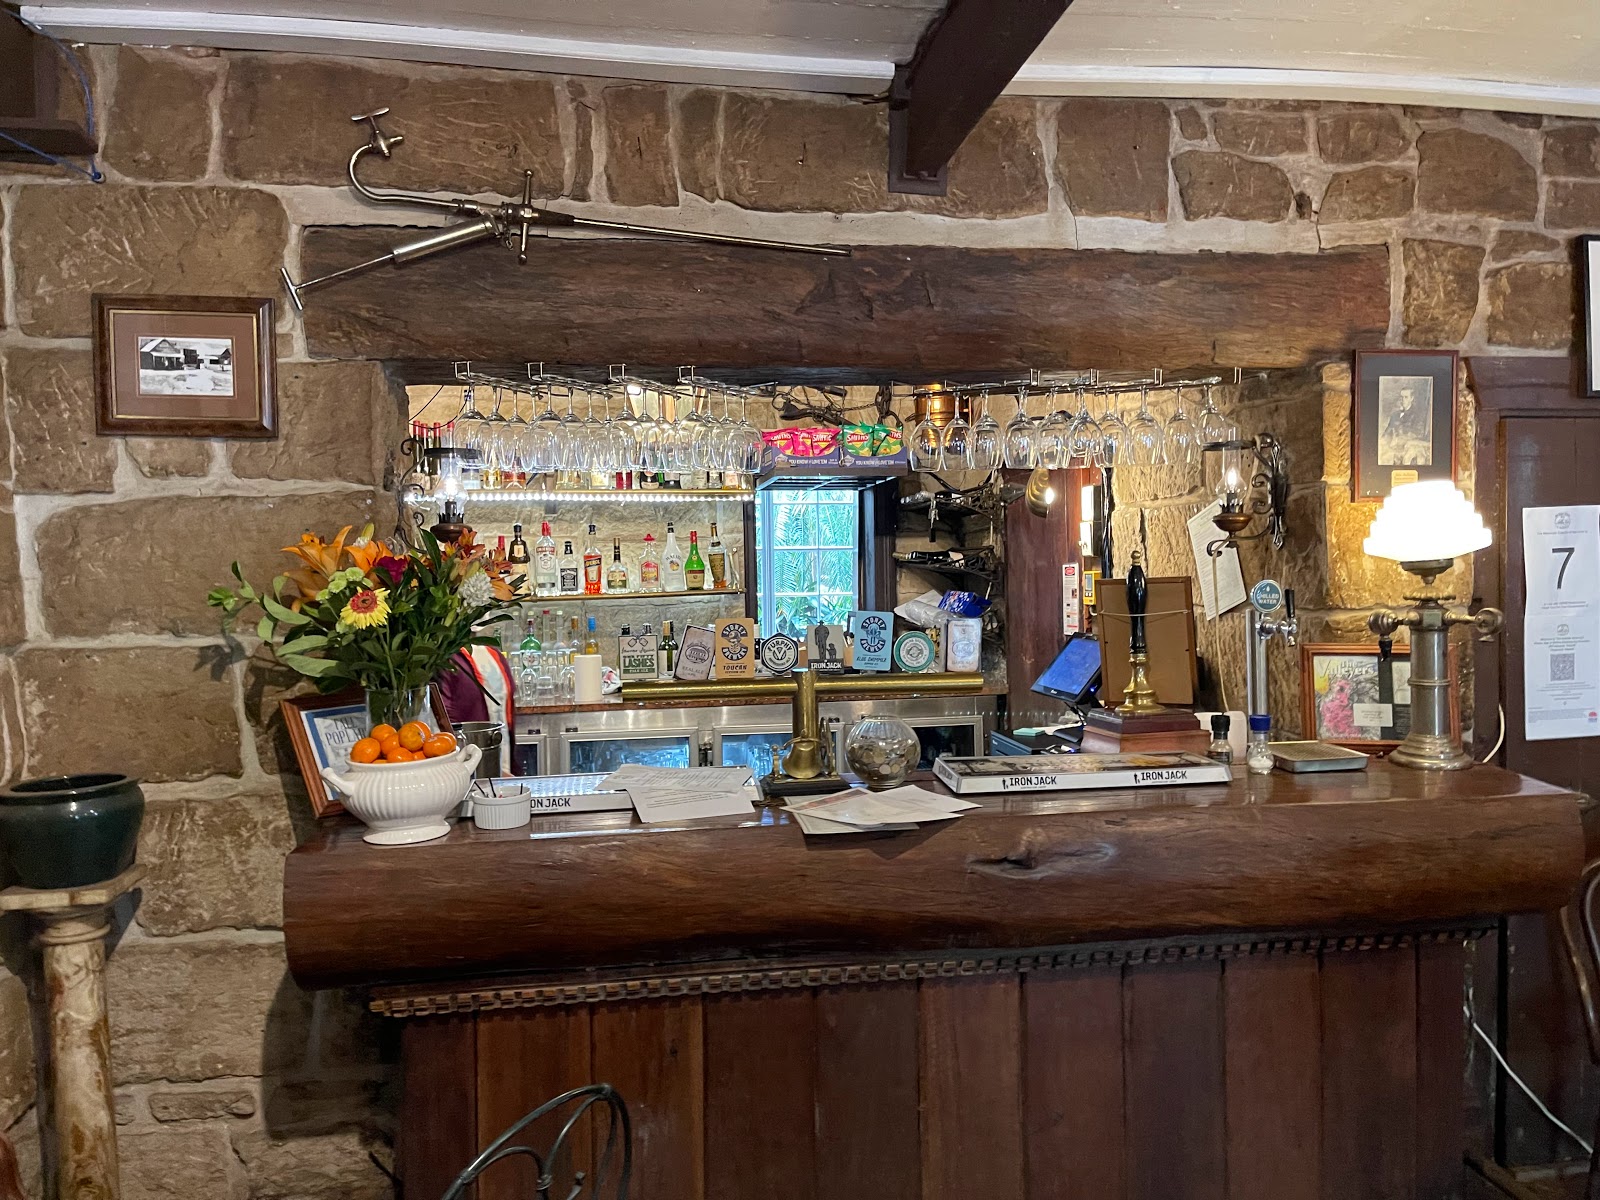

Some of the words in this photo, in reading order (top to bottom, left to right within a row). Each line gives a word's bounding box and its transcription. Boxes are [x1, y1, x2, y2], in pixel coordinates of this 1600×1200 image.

[1551, 547, 1575, 590] 7
[767, 640, 793, 652] FURPHY
[623, 657, 655, 668] LASHES
[811, 661, 826, 669] IRON
[826, 661, 842, 669] JACK
[1009, 776, 1032, 786] IRON
[1033, 775, 1057, 786] JACK
[1141, 771, 1164, 781] IRON
[1164, 770, 1188, 780] JACK
[530, 798, 544, 808] ON
[544, 797, 571, 808] JACK
